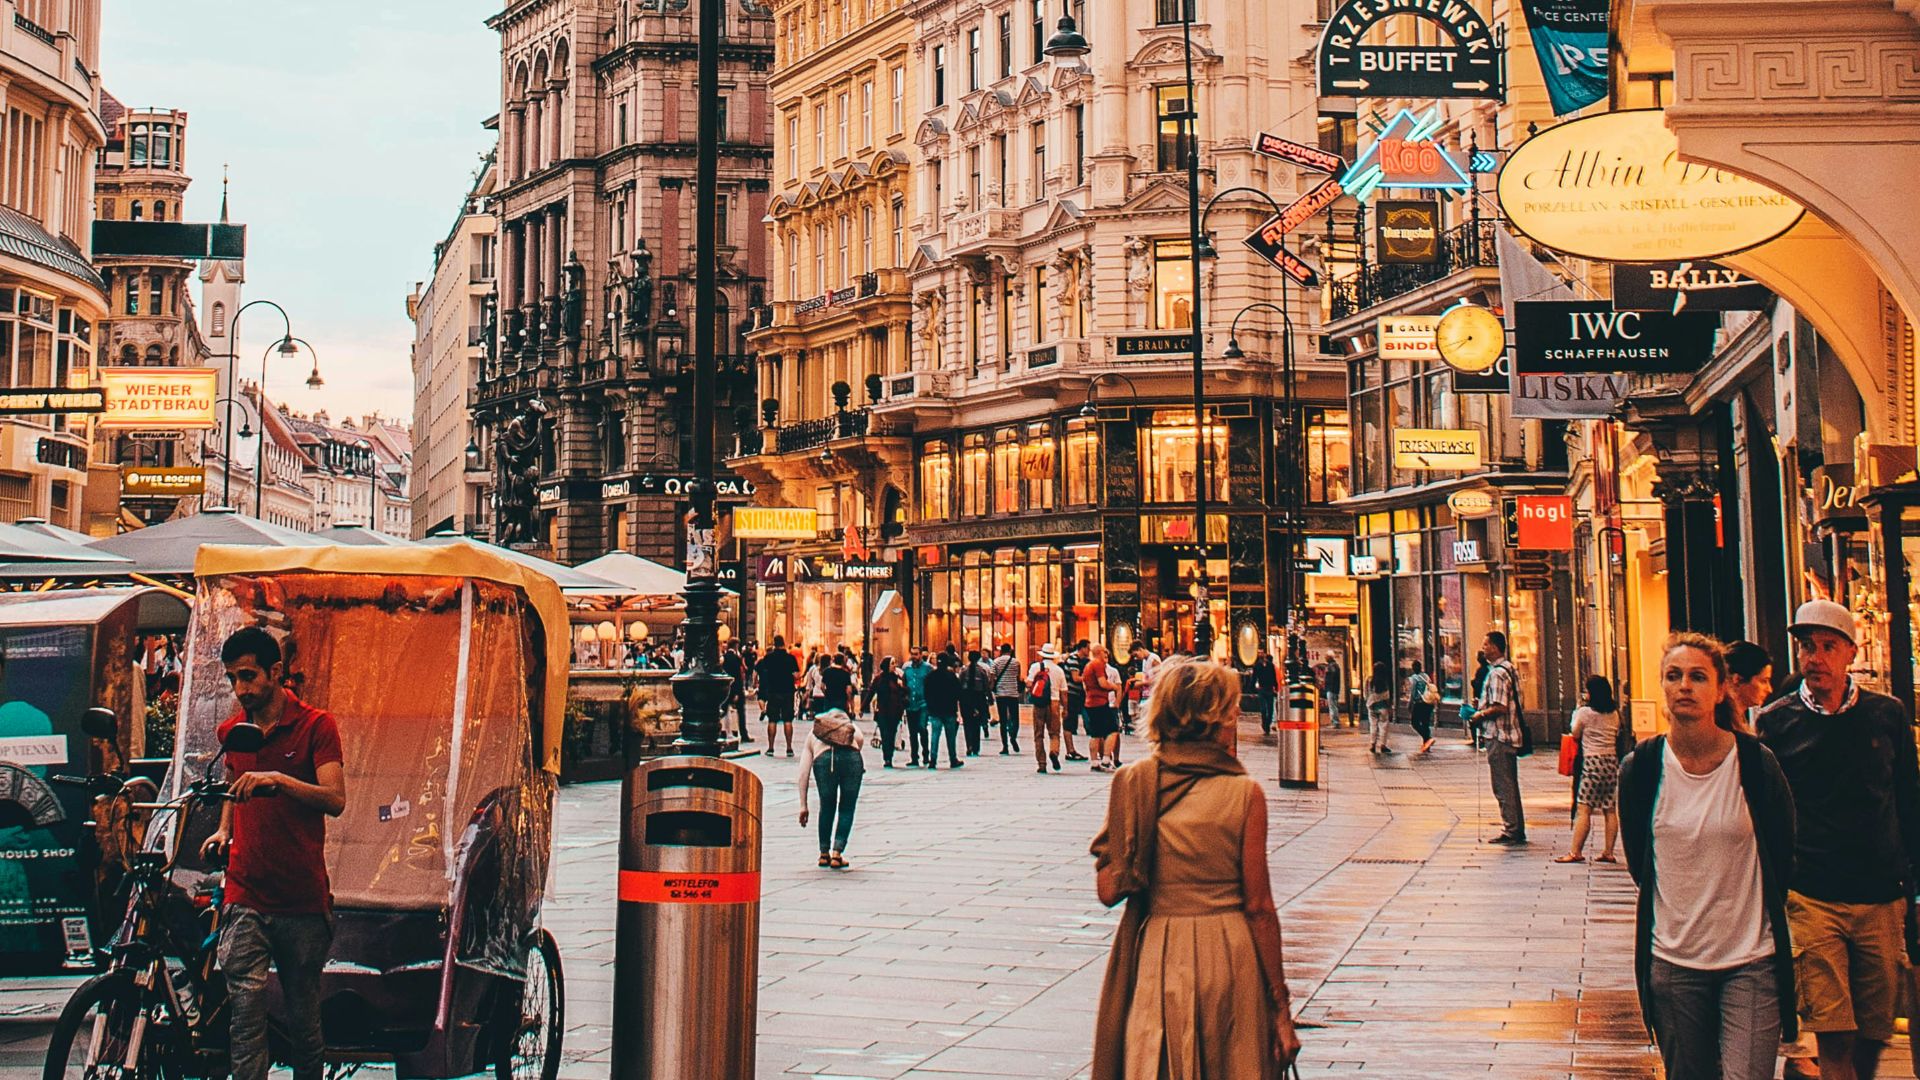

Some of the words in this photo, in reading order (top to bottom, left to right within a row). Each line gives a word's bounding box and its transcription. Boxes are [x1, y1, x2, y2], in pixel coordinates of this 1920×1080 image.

[1360, 51, 1458, 72] BUFFET
[1262, 136, 1339, 166] DISCOTHEQUE
[1523, 149, 1645, 191] Albin
[1523, 202, 1609, 214] PORZELLAN
[1619, 199, 1690, 210] KRISTALL
[1699, 195, 1790, 208] GESCHENKE
[1650, 269, 1740, 289] BALLY
[1569, 312, 1641, 340] IWC
[1138, 340, 1170, 351] BRAUN
[1545, 348, 1669, 359] SCHAFFHAUSEN
[126, 384, 192, 396] WIENER
[1517, 375, 1621, 401] LISKA
[139, 475, 163, 483] YVES
[164, 475, 202, 483] ROCHER
[1453, 540, 1480, 562] FOSSIL
[42, 848, 75, 858] SHOP
[664, 879, 720, 888] MISTTELEFON
